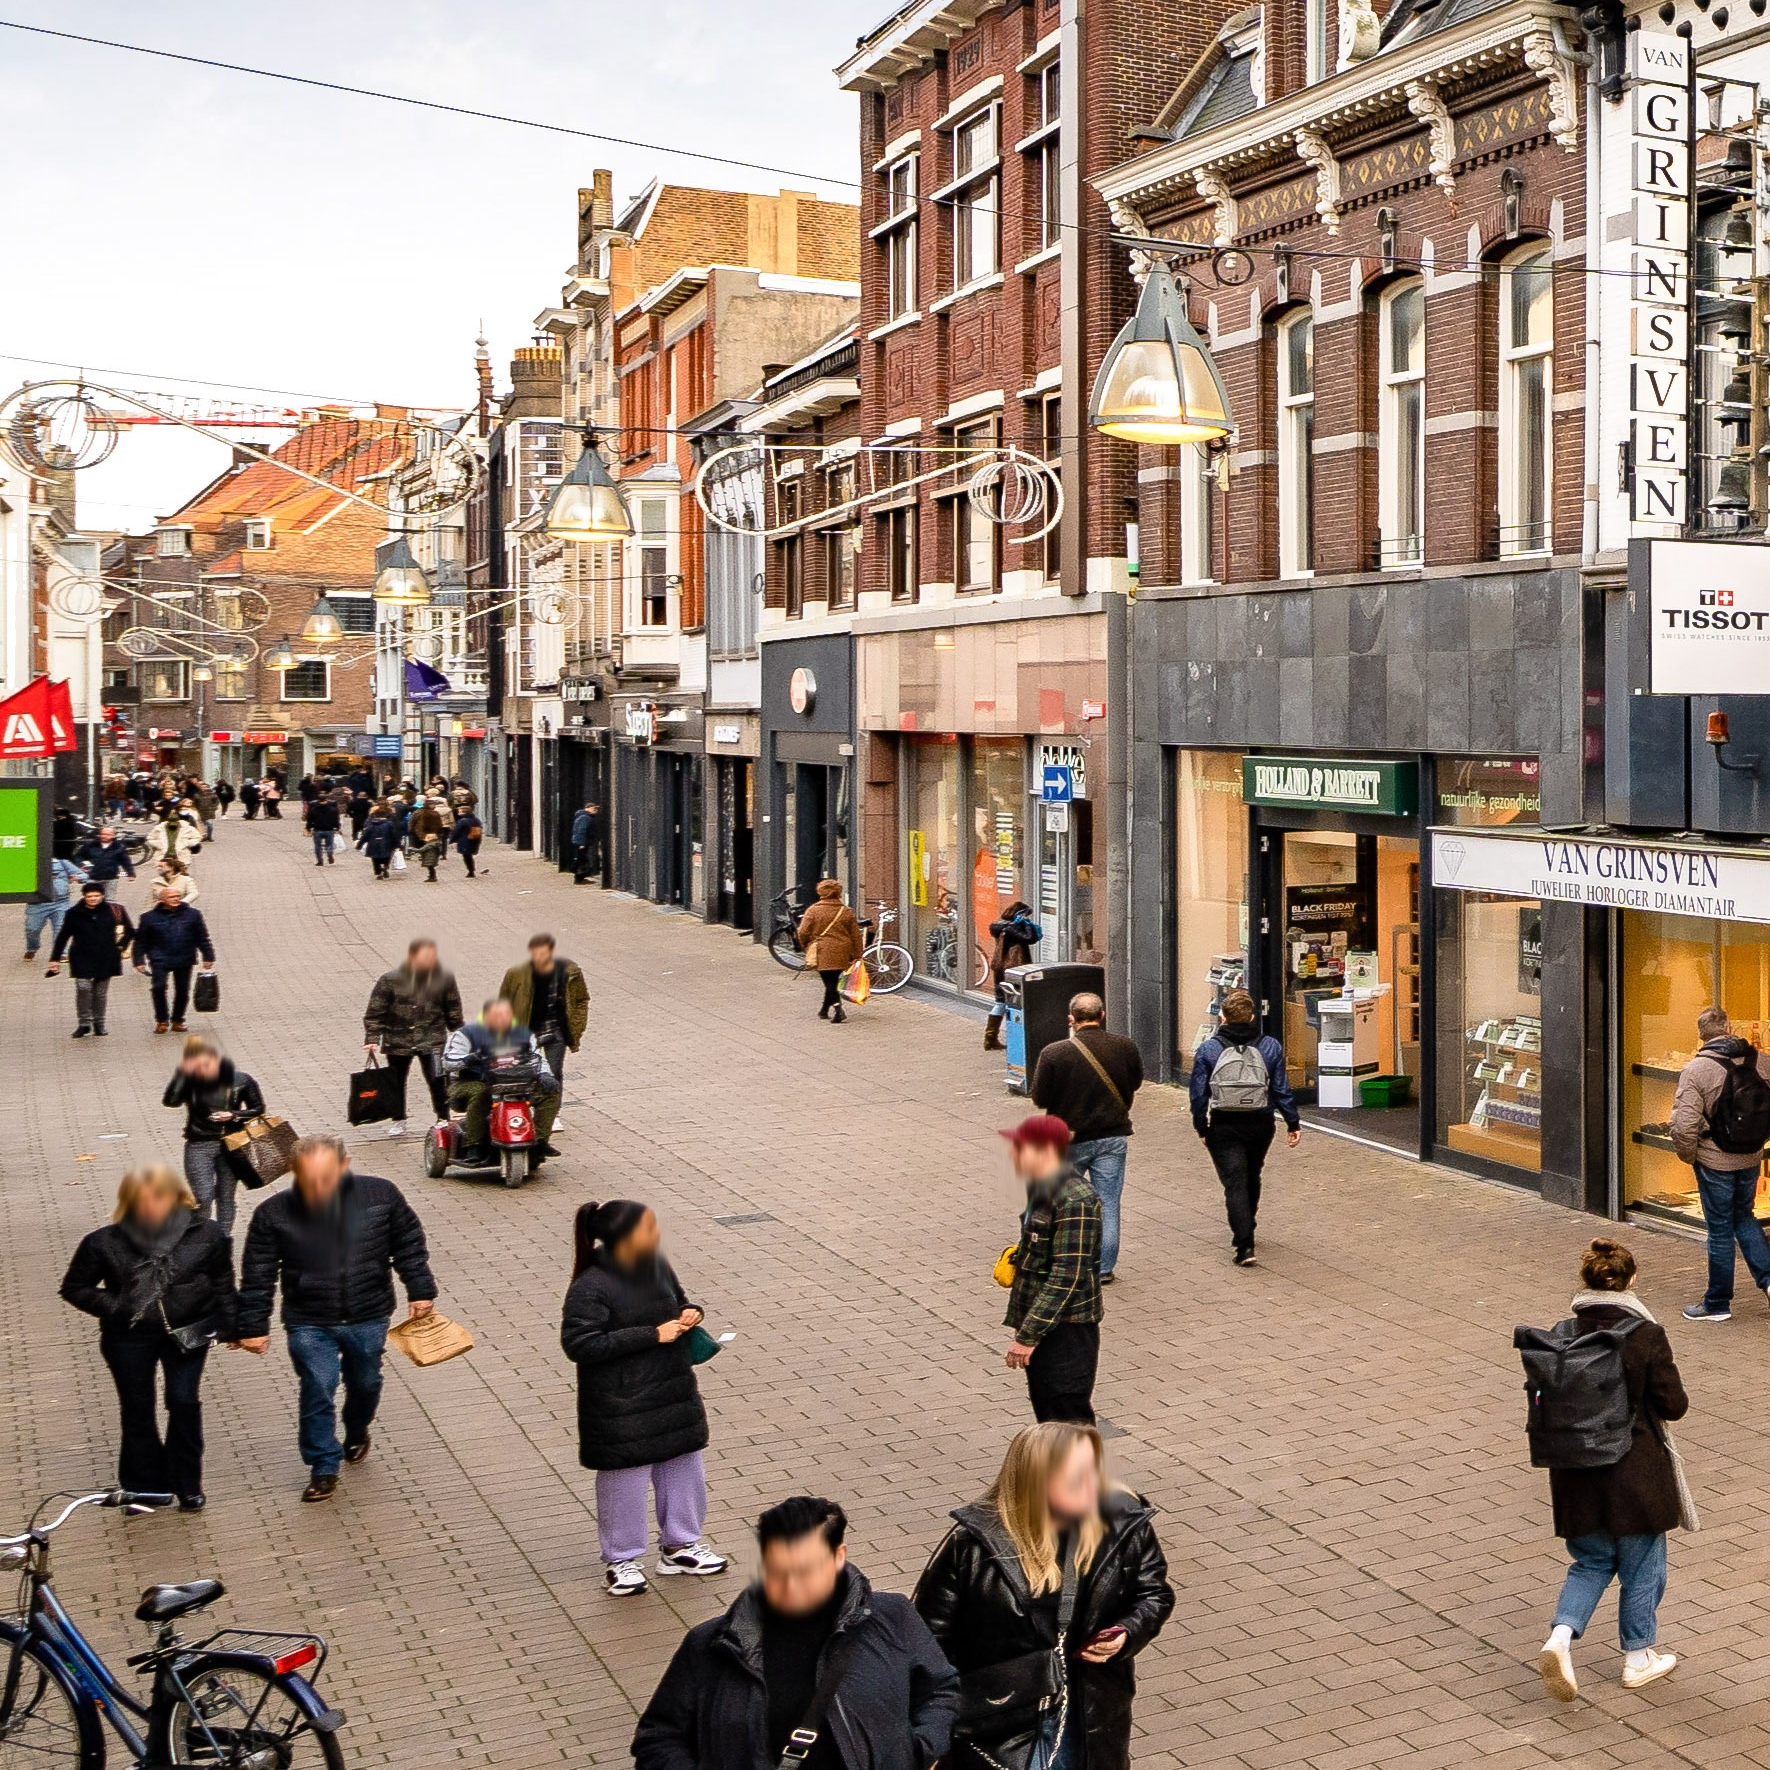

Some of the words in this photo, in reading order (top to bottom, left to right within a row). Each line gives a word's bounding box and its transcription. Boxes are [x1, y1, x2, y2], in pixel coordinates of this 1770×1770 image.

[1642, 45, 1684, 70] VAN
[1642, 94, 1678, 519] GRINSVEN
[1662, 609, 1769, 630] TISSOT
[1661, 632, 1686, 640] SWISS
[1690, 633, 1725, 641] WATCHES
[1728, 634, 1751, 642] SINCE
[1254, 765, 1309, 797] HOLLAND
[1310, 767, 1323, 802] &
[1323, 768, 1380, 800] BARRETT
[1440, 790, 1487, 813] natuurlijke
[1489, 791, 1541, 815] gezondheid
[1541, 841, 1590, 876] VAN
[1596, 845, 1721, 889] GRINSVEN
[1291, 904, 1323, 913] BLACK
[1324, 902, 1357, 911] FRIDAY
[1531, 879, 1582, 901] JUWELIER
[1586, 885, 1650, 909] HORLOGER
[1654, 892, 1737, 917] DIAMANTAIR
